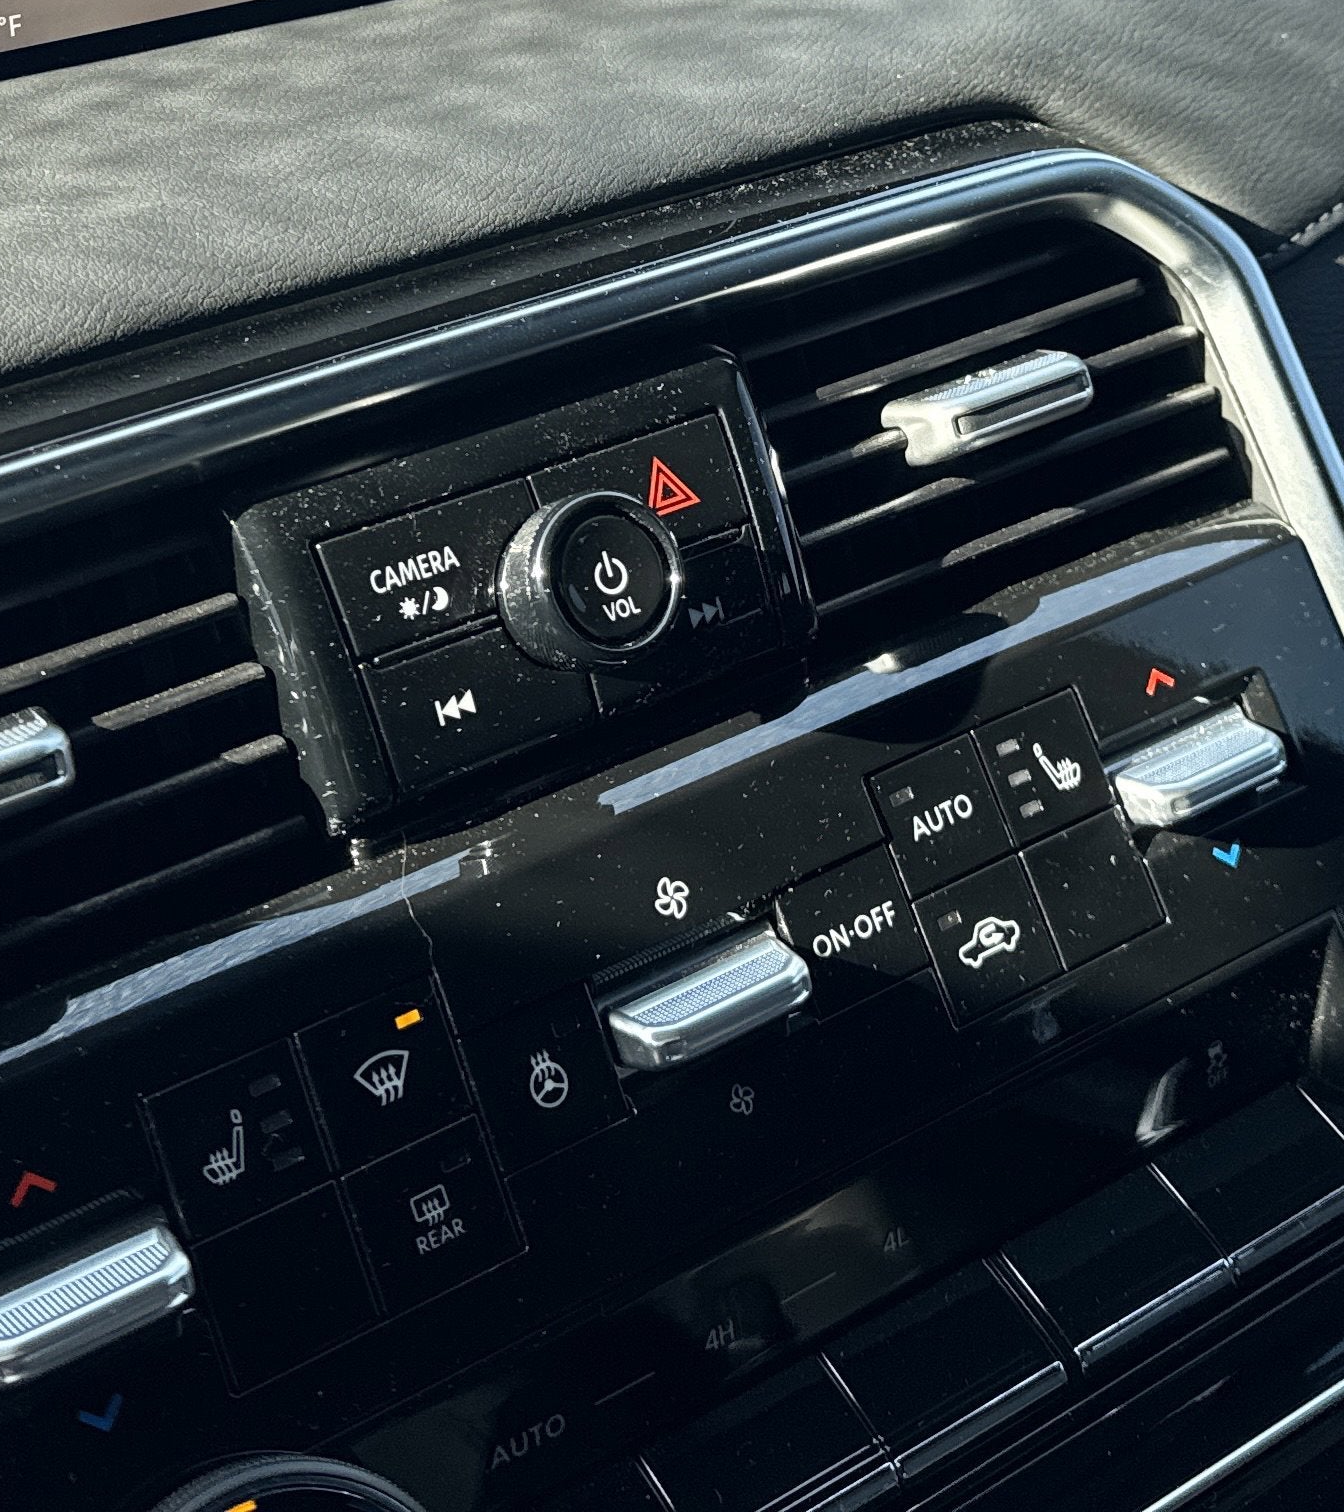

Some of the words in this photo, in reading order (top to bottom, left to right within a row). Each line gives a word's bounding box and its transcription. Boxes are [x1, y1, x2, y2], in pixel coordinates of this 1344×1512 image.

[369, 545, 460, 594] CAMERA
[602, 596, 642, 622] VOL
[912, 794, 974, 840] AUTO
[416, 1218, 467, 1254] REAR
[884, 1228, 908, 1252] 4L
[705, 1321, 735, 1350] 4H
[491, 1414, 567, 1470] AUTO
